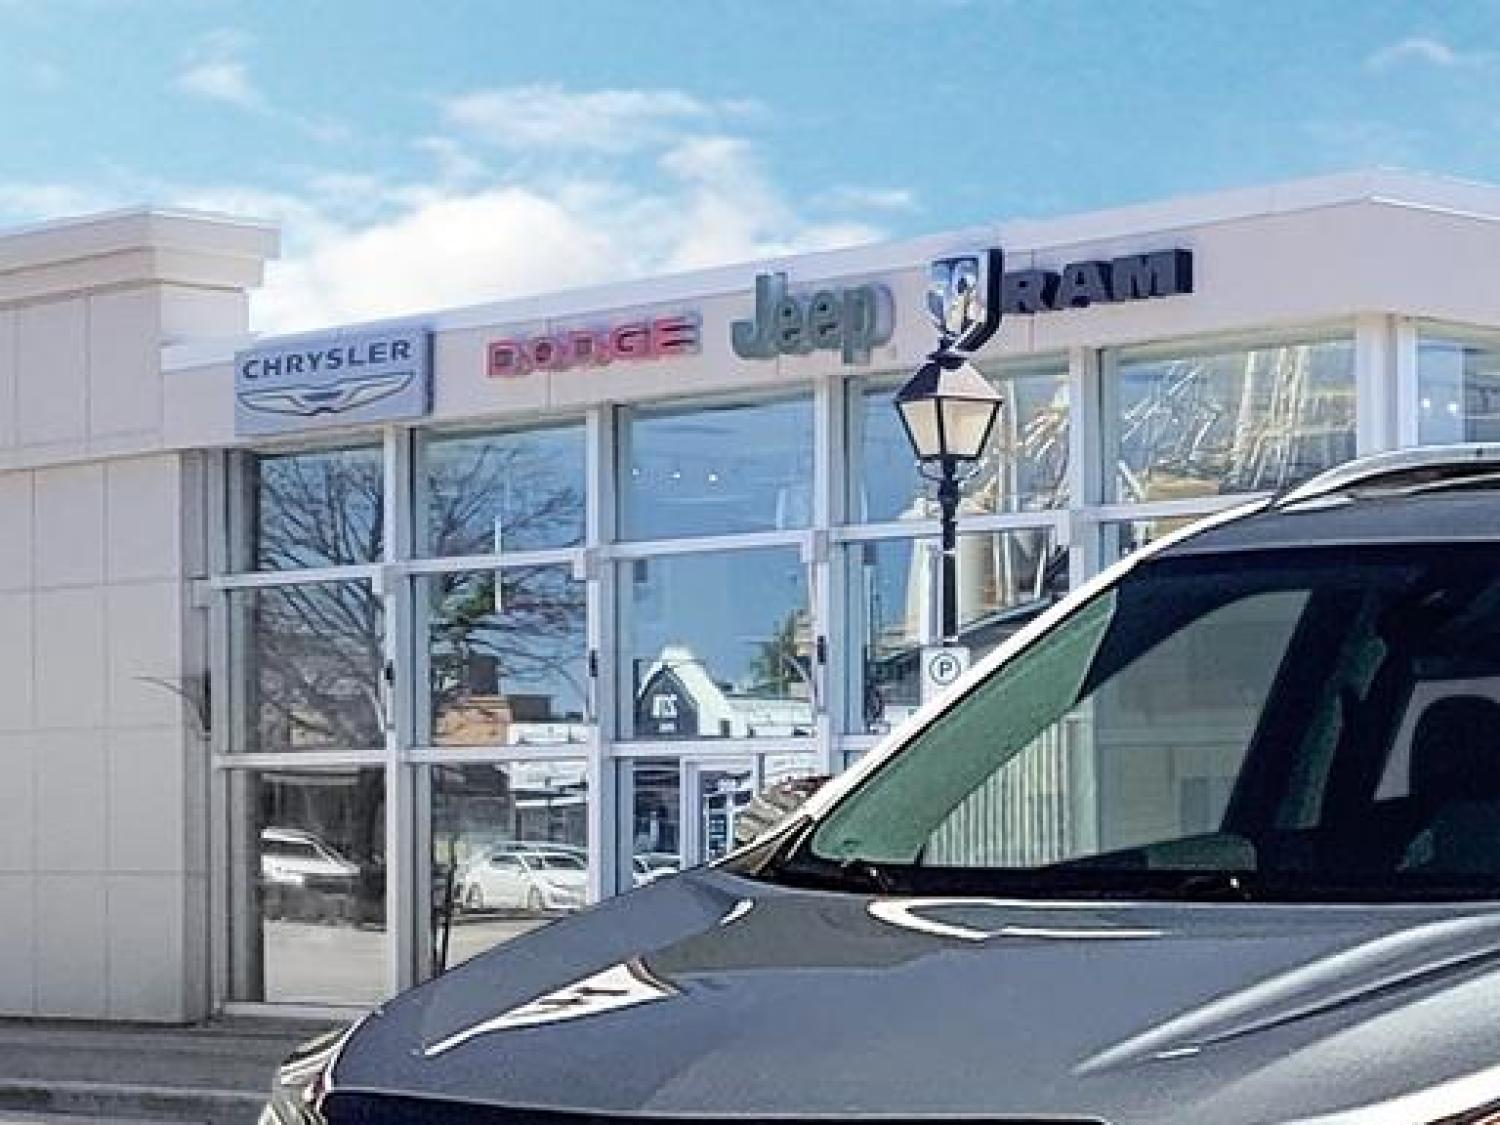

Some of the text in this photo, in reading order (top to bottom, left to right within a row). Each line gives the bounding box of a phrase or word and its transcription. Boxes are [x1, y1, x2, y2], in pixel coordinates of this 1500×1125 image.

[1002, 249, 1194, 313] RAM
[486, 311, 702, 378] DODGE
[731, 271, 896, 364] Jeep
[241, 340, 412, 380] CHRYSLER
[939, 661, 953, 678] P
